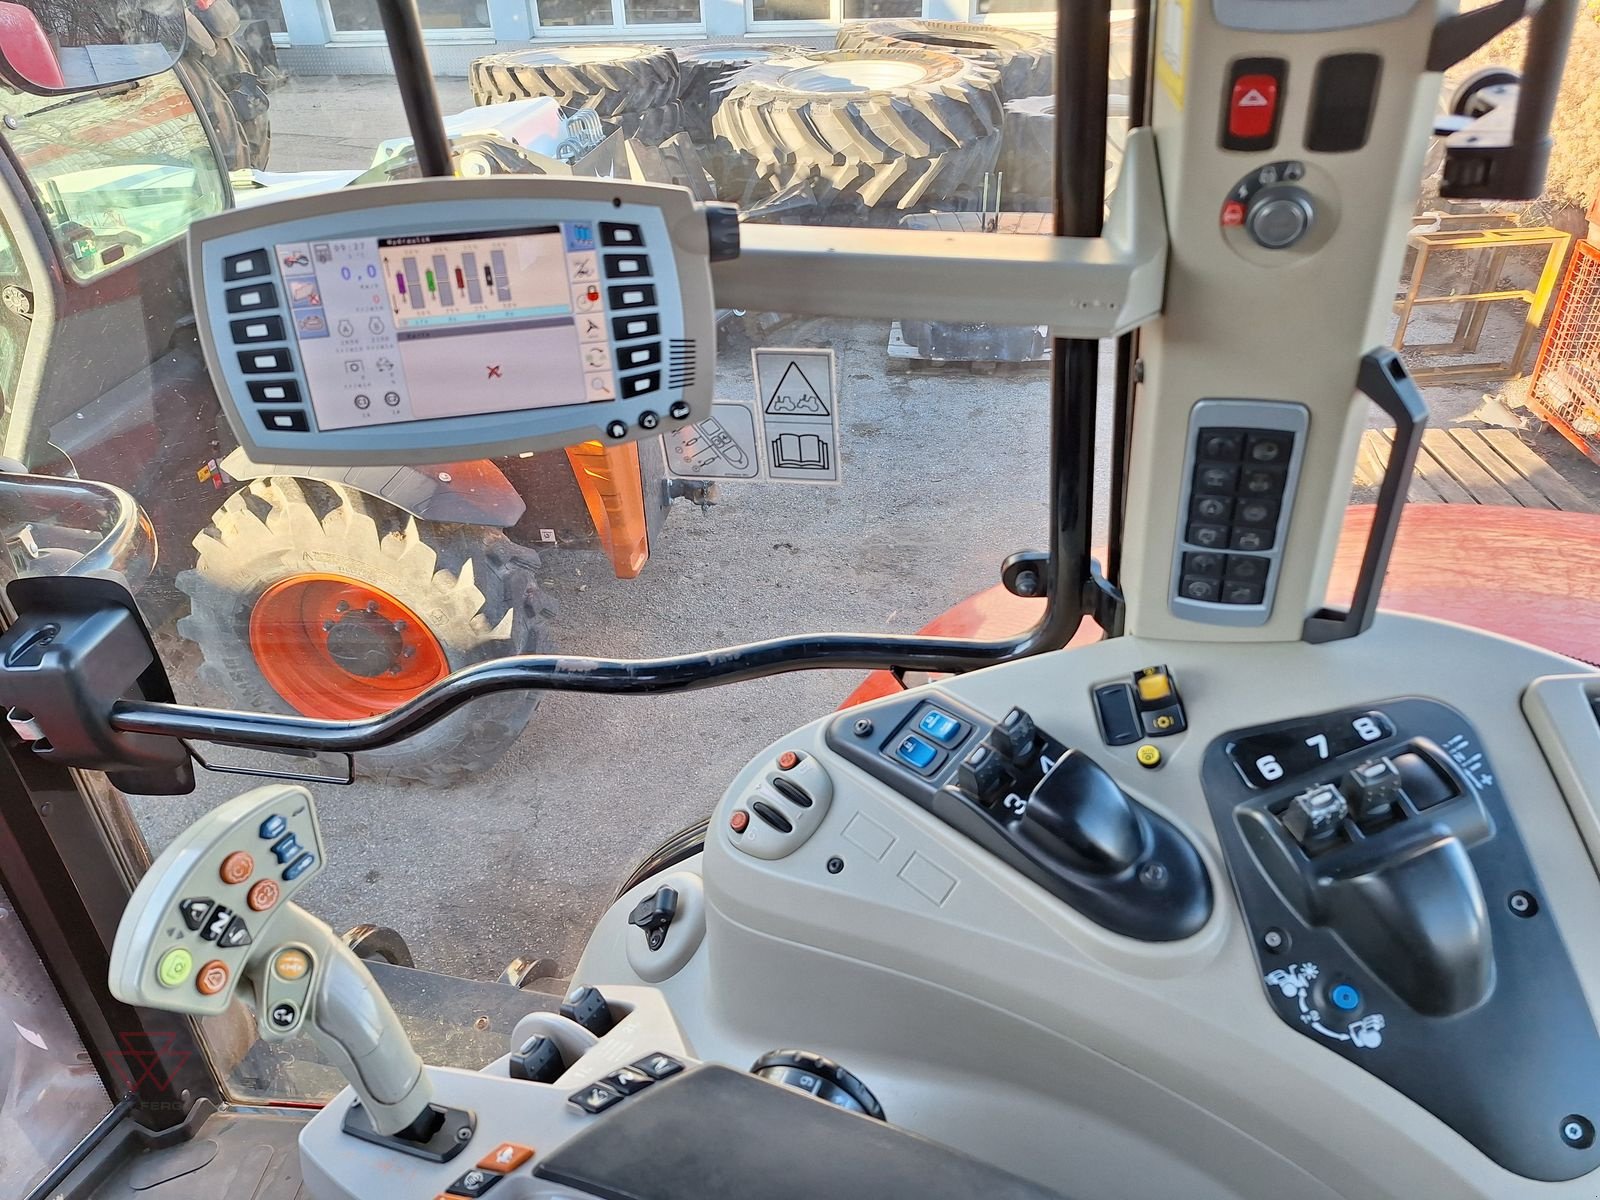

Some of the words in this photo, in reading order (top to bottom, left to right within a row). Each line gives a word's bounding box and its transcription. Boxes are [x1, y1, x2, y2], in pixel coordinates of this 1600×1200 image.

[1352, 716, 1382, 743] 8
[1304, 734, 1328, 760] 7
[1255, 754, 1284, 782] 6
[1003, 792, 1028, 816] 3
